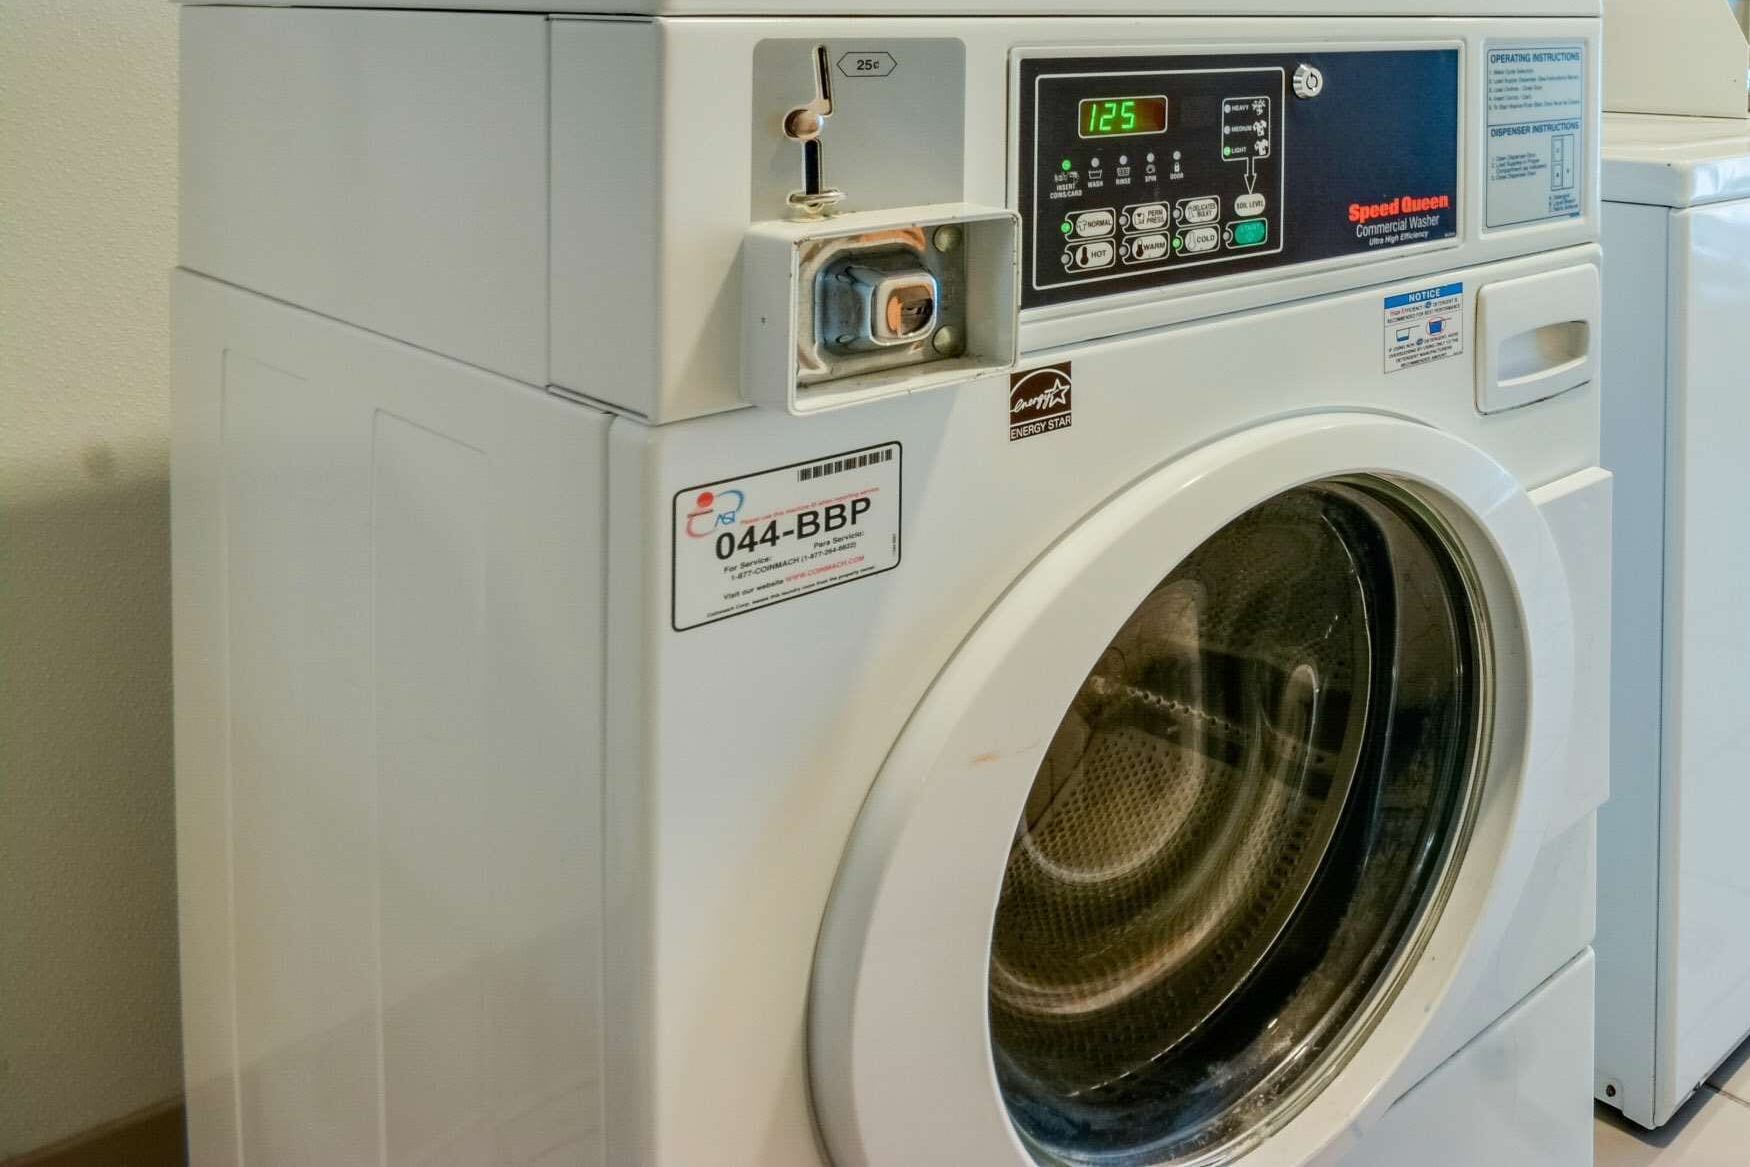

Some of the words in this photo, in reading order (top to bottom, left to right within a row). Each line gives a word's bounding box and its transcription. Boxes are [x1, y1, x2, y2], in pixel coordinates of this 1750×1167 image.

[1490, 53, 1531, 64] OPERATING
[1532, 52, 1580, 63] INSTRUCTIONS
[1231, 104, 1250, 112] HEAVY
[1088, 101, 1136, 132] 125
[1490, 126, 1531, 138] DISPENSER
[1532, 121, 1580, 134] INSTRUCTIONS
[1232, 146, 1248, 154] LIGHT
[1087, 180, 1104, 188] WASH
[1115, 177, 1131, 186] RINSE
[1144, 175, 1157, 183] SPIN
[1056, 183, 1076, 191] INSERT
[1236, 202, 1248, 210] SOIL
[1249, 200, 1264, 209] LEVEL
[1348, 197, 1400, 224] Speed
[1401, 195, 1449, 214] Queen
[1147, 210, 1163, 218] PERM
[1087, 218, 1112, 228] NORMAL
[1146, 216, 1165, 225] PRESS
[1356, 218, 1407, 238] Commercial
[1409, 214, 1440, 229] Washer
[1196, 235, 1215, 243] COLD
[1368, 236, 1384, 246] Ultra
[1385, 234, 1399, 244] High
[1400, 231, 1429, 241] Efficiency
[1143, 241, 1166, 251] WARM
[1091, 249, 1107, 258] HOT
[1408, 289, 1441, 302] NOTICE
[1010, 420, 1047, 440] ENERGY
[1048, 415, 1072, 430] STAR
[715, 496, 872, 561] 044-BBP
[723, 565, 738, 575] For
[739, 556, 773, 571] Service:
[813, 539, 831, 550] Para
[730, 556, 800, 582] 1-877-COINMACH
[723, 589, 740, 601] Visit
[741, 587, 755, 596] our
[756, 577, 785, 592] website
